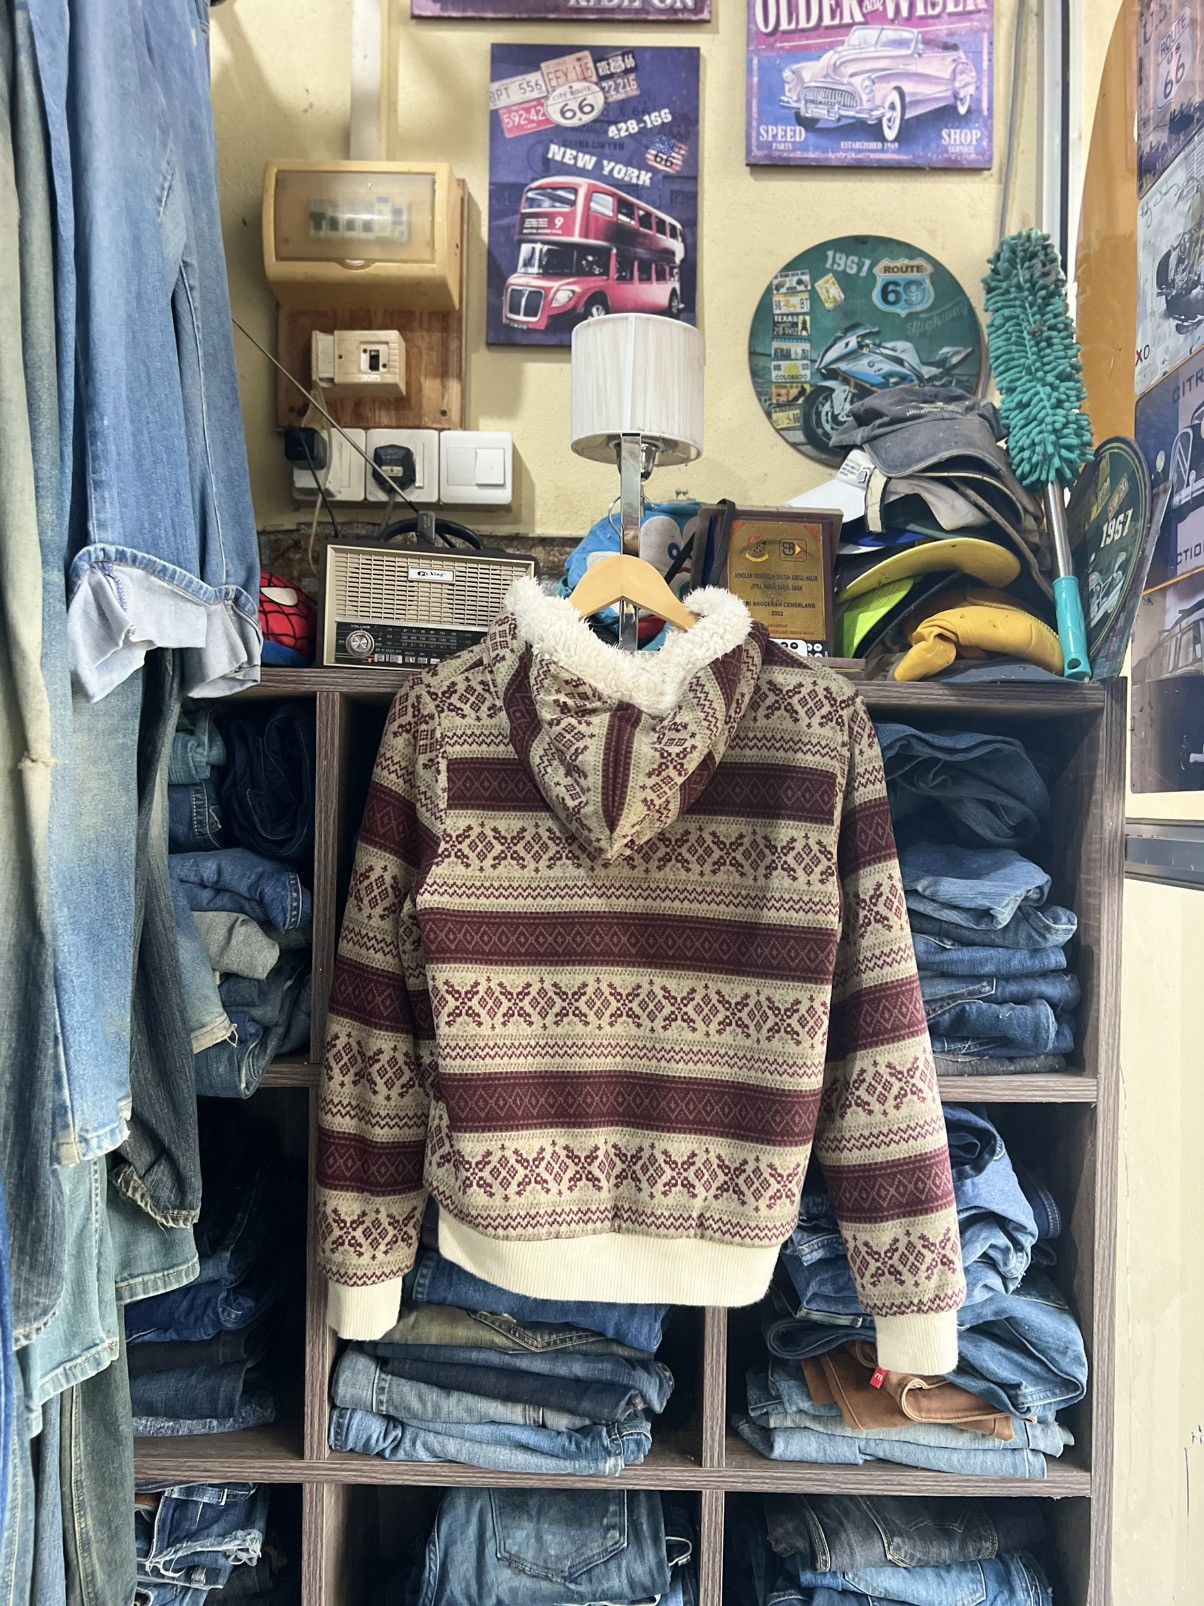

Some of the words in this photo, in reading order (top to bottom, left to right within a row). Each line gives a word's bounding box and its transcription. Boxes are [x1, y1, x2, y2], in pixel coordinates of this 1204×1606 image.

[754, 0, 865, 33] OLDER
[1164, 54, 1185, 99] 66
[518, 79, 543, 95] 556
[560, 97, 595, 120] 66
[759, 125, 806, 142] SPEED
[941, 128, 981, 145] SHOP
[772, 142, 793, 151] PARTS
[547, 143, 598, 170] NEW
[602, 159, 653, 187] YORK
[654, 152, 676, 168] 66
[554, 216, 565, 229] 9
[825, 250, 871, 277] 1967
[883, 264, 925, 274] ROUTE
[880, 280, 926, 306] 69
[773, 315, 798, 323] TEXAS
